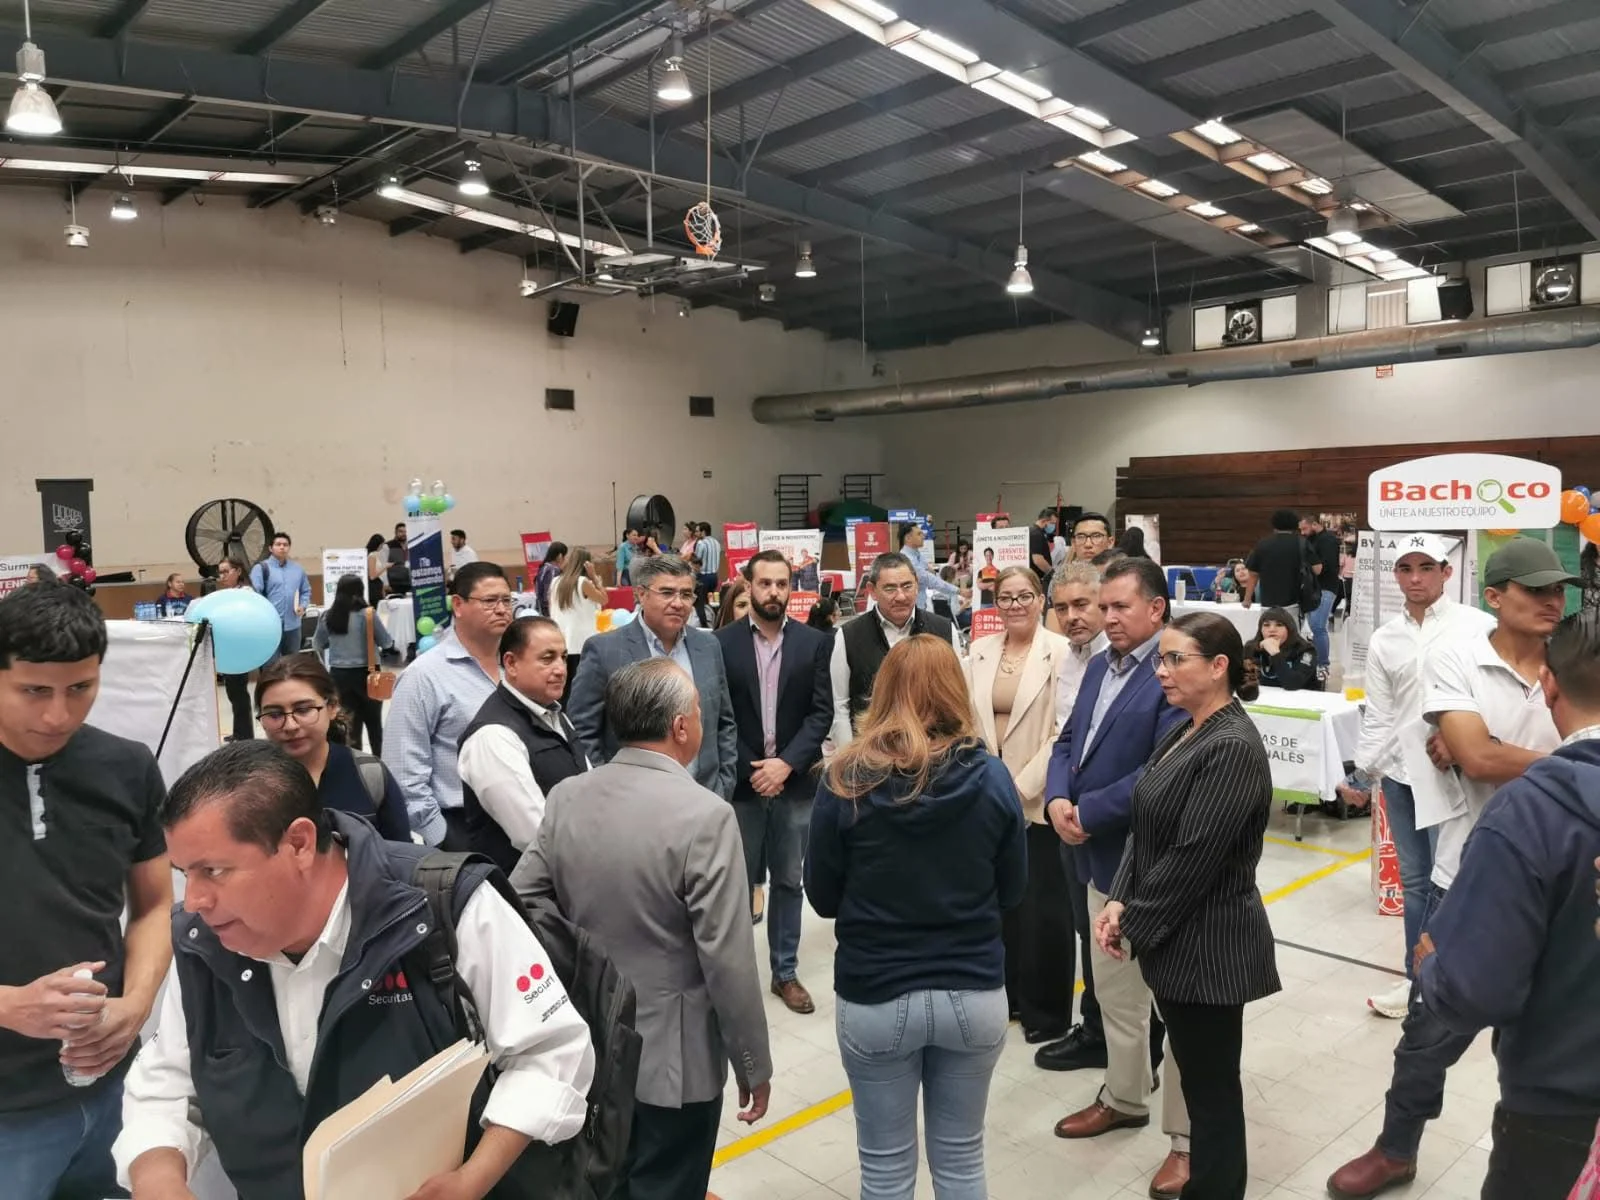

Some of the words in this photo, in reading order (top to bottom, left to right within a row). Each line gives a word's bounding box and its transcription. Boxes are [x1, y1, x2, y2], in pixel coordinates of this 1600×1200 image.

[1418, 506, 1460, 518] NUESTRO
[1461, 506, 1496, 517] EQUIPO
[1281, 736, 1299, 748] DE
[368, 992, 414, 1006] Securitas
